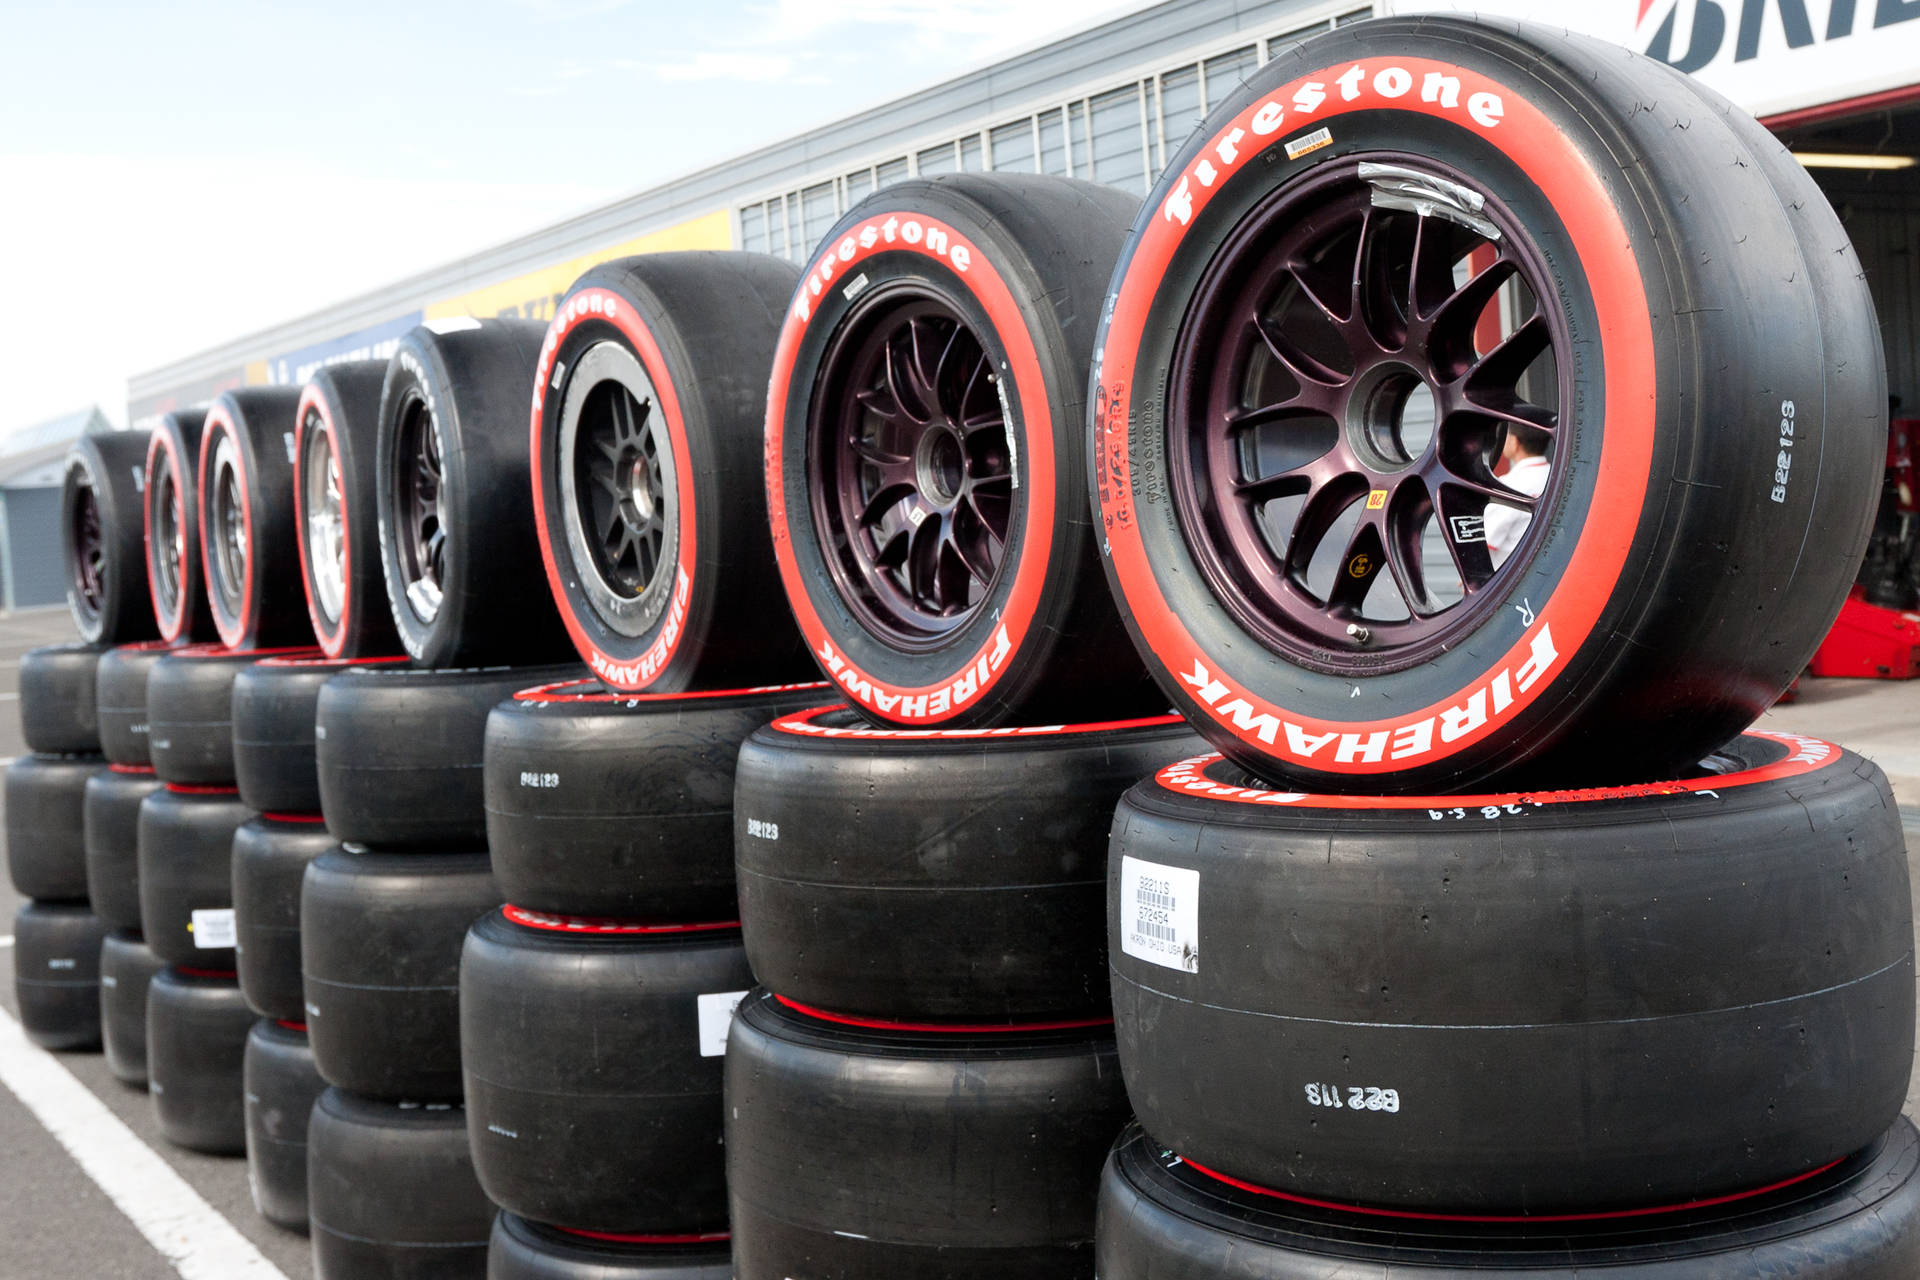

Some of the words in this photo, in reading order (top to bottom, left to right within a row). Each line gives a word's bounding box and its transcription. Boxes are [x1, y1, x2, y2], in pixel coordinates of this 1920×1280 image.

[1164, 63, 1506, 227] Firestone
[794, 215, 971, 324] Firestone
[533, 294, 617, 412] Firestone
[1142, 399, 1162, 504] Firestone
[1370, 493, 1384, 507] 28
[591, 562, 691, 687] FIREHAWK
[818, 623, 1012, 718] FIREHAWK
[1180, 622, 1561, 764] FIREHAWK
